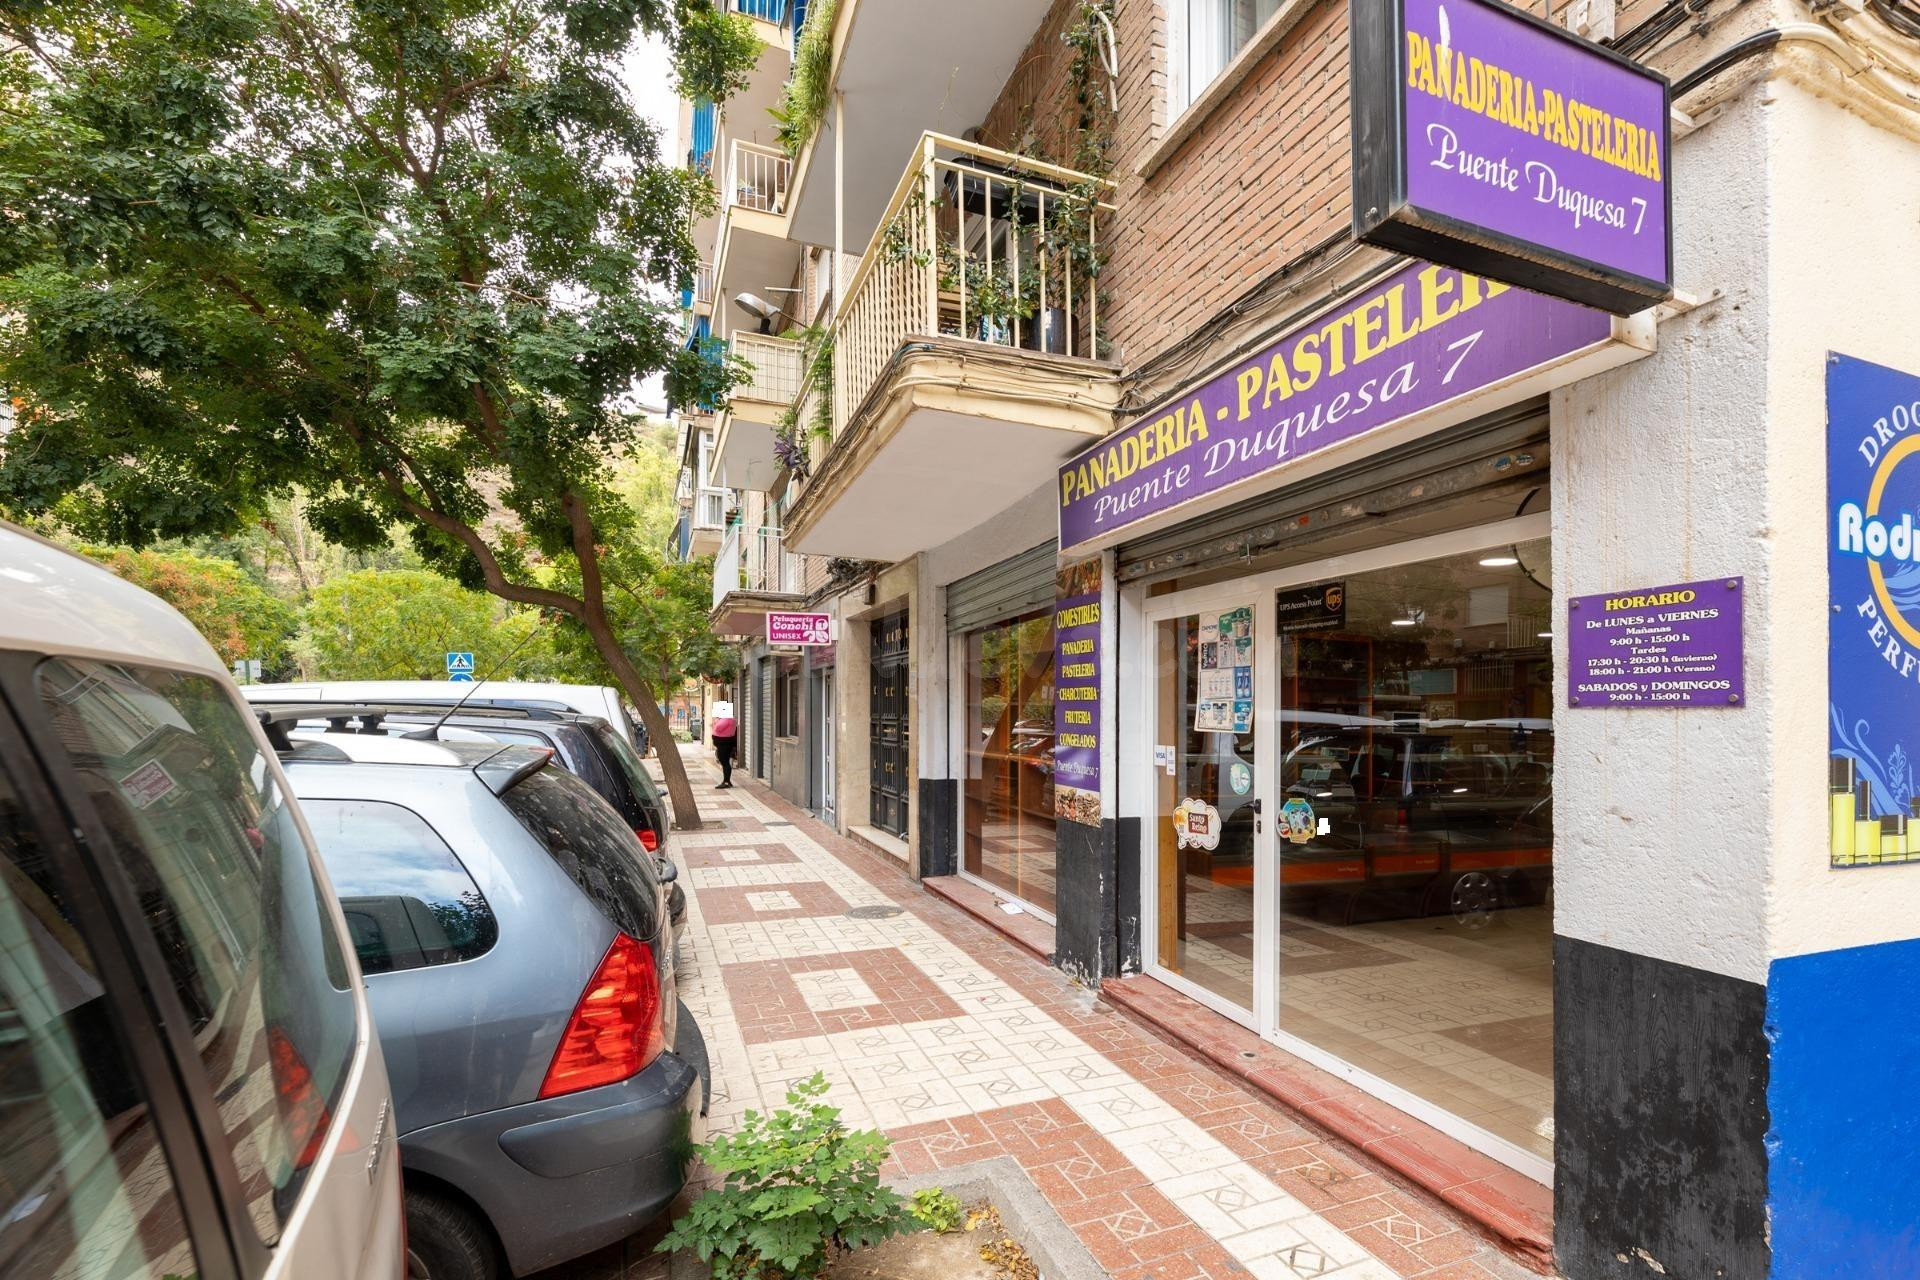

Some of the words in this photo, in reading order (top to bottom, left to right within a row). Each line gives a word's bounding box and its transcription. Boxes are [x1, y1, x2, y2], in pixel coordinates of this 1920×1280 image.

[1426, 123, 1519, 192] Puente
[1525, 161, 1625, 229] Duquesa
[1631, 197, 1647, 235] 7
[1093, 462, 1192, 524] Puente
[1203, 360, 1420, 478] Duquesa
[1441, 329, 1484, 385] 7
[1062, 399, 1209, 506] PANADERIA
[1280, 603, 1290, 611] UPS
[1605, 590, 1696, 611] HORARIO
[1057, 603, 1100, 629] COMESTIBLES
[1586, 620, 1602, 629] De
[1604, 615, 1644, 628] LUNES
[1647, 616, 1655, 624] a
[1657, 608, 1719, 623] VIERNES
[772, 622, 813, 631] Conchi
[1626, 625, 1672, 635] Mañanas
[1610, 637, 1633, 646] 9:00
[1635, 636, 1642, 645] h
[1651, 634, 1680, 643] 15:00
[1682, 633, 1690, 642] h
[1062, 639, 1094, 656] PANADERIA
[1630, 646, 1667, 655] Tardes
[1587, 658, 1613, 667] 17:30
[1614, 657, 1621, 665] h
[1629, 655, 1659, 664] 20:30
[1661, 654, 1669, 663] h
[1671, 653, 1717, 663] (Invierno)
[1062, 663, 1096, 678] PASTELERIA
[1589, 667, 1615, 676] 18:00
[1617, 666, 1625, 675] h
[1632, 665, 1662, 674] 21:00
[1663, 664, 1672, 673] h
[1673, 664, 1715, 673] (Verano)
[1578, 682, 1638, 692] SABADOS
[1641, 683, 1648, 693] y
[1651, 680, 1731, 691] DOMINGOS
[1609, 693, 1633, 701] 9:00
[1635, 693, 1642, 701] h
[1651, 692, 1680, 701] 15:00
[1682, 692, 1691, 700] h
[1064, 711, 1092, 725] FRUTERIA
[1059, 733, 1097, 749] CONGELADOS
